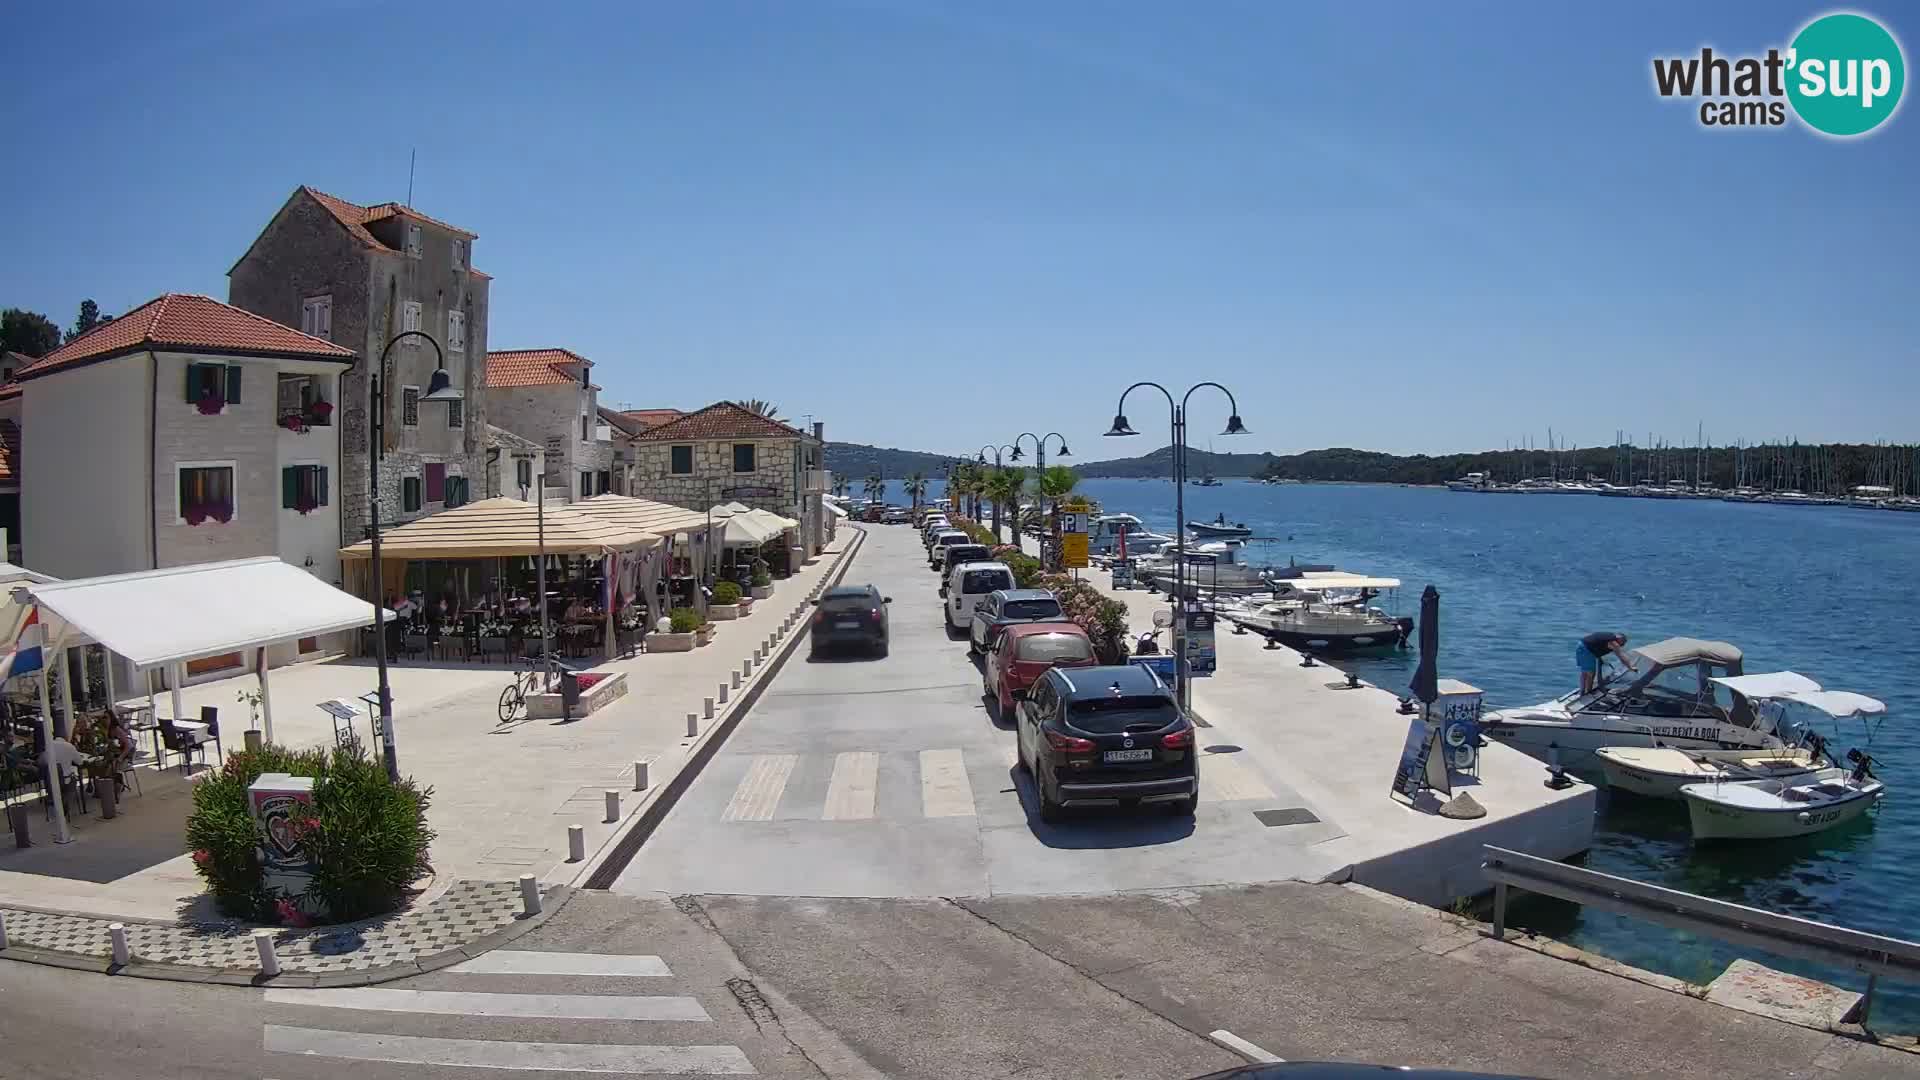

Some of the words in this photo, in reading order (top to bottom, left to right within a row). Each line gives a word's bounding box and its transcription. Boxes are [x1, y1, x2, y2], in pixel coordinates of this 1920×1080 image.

[1065, 515, 1075, 530] P
[1447, 703, 1478, 712] RENT
[1672, 727, 1693, 737] RENT
[1701, 728, 1721, 741] BOAT
